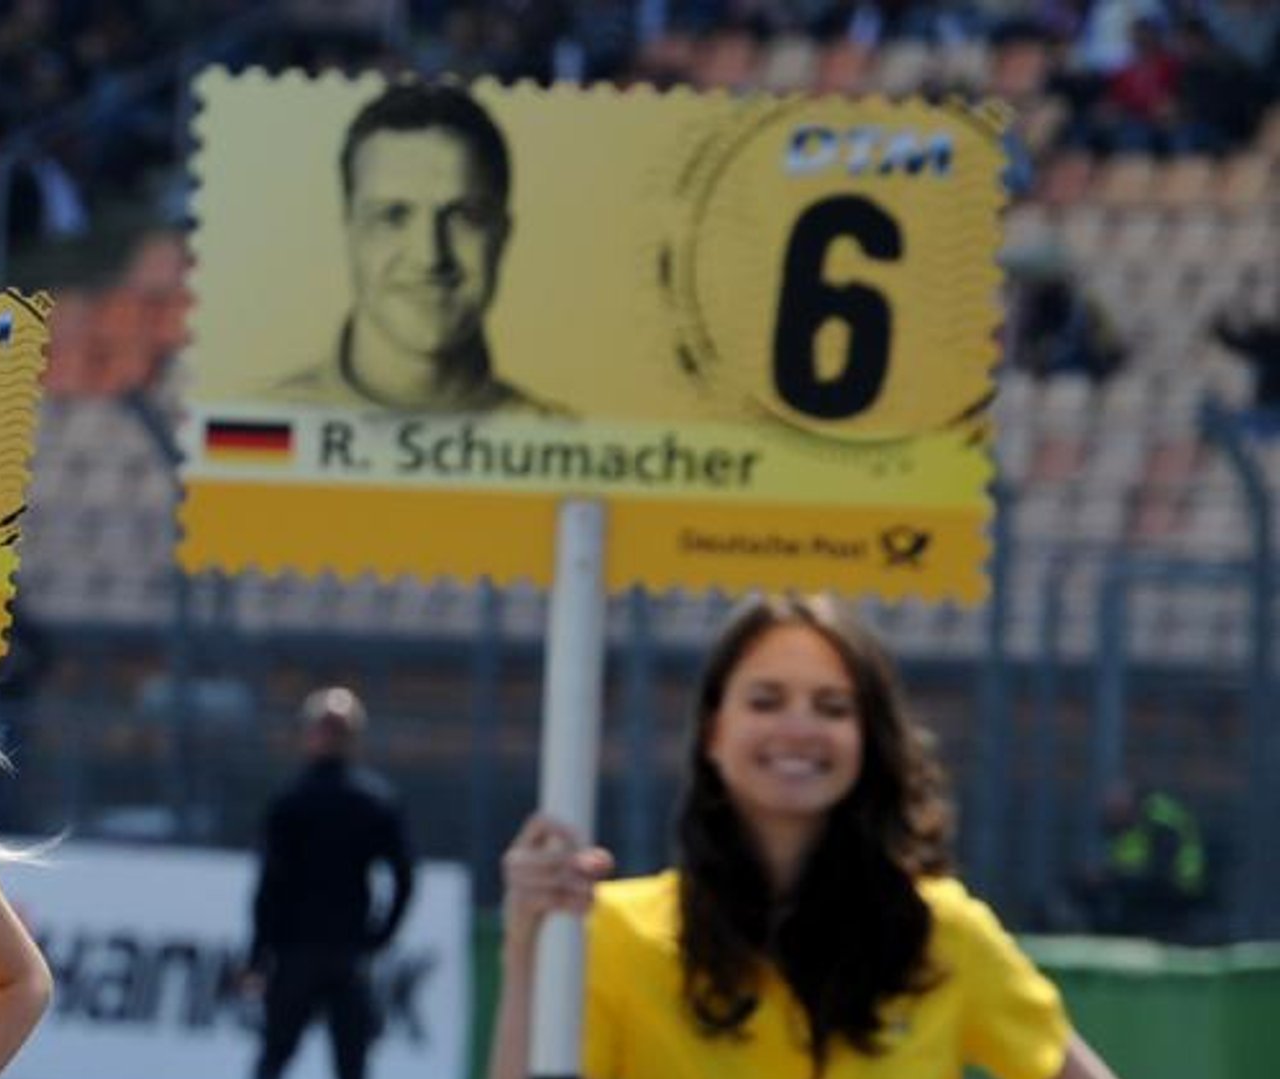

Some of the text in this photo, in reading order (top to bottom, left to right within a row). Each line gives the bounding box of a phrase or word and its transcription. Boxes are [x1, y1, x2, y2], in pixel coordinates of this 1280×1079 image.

[784, 124, 954, 178] DTM
[771, 193, 903, 420] 6
[319, 419, 761, 486] R. Schumacher
